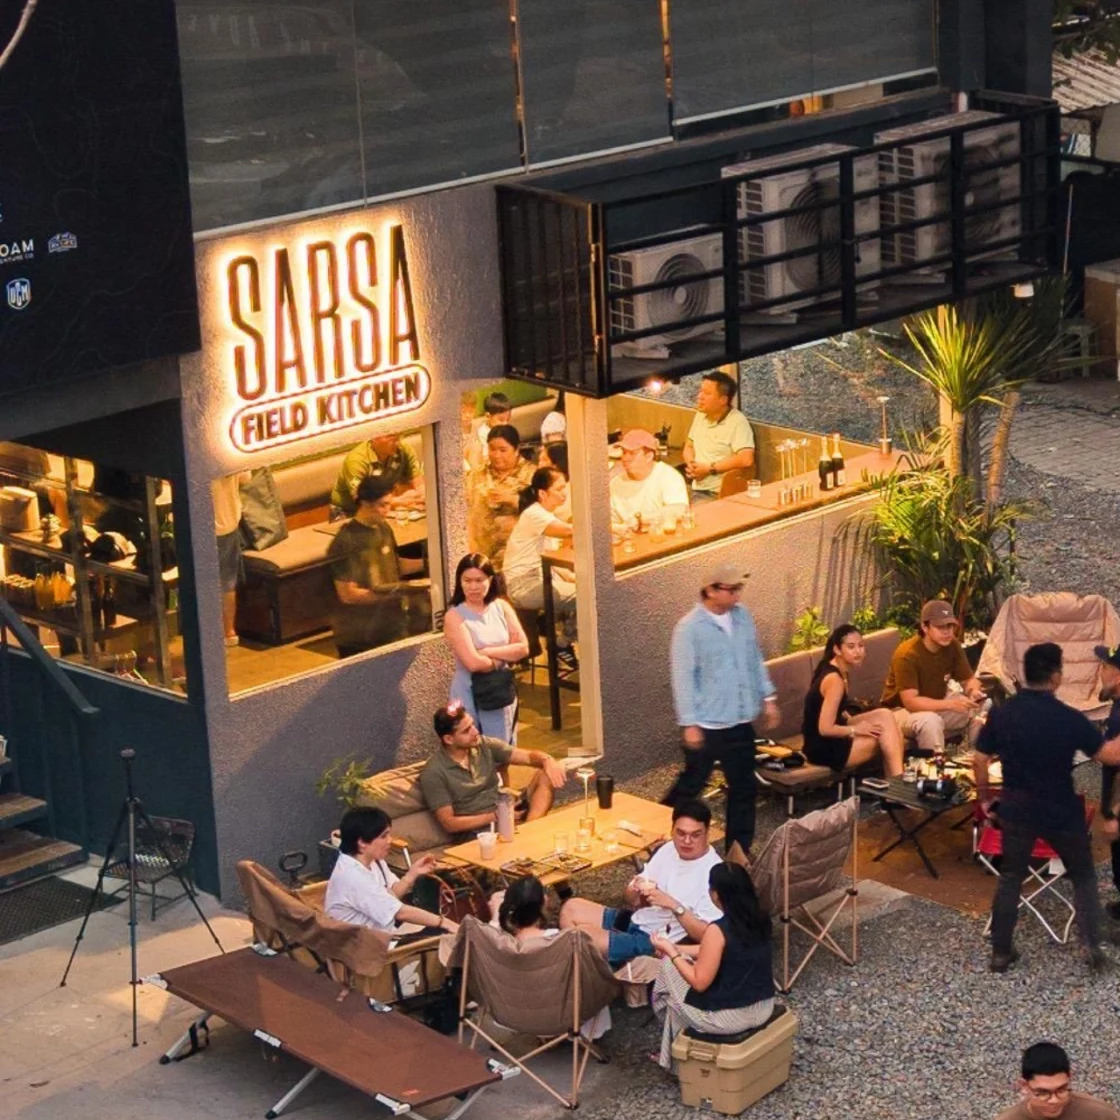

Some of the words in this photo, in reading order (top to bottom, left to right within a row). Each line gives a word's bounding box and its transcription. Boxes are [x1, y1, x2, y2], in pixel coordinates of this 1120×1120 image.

[227, 224, 420, 400] SARSA
[241, 402, 308, 445] FIELD
[316, 372, 421, 425] KITCHEN
